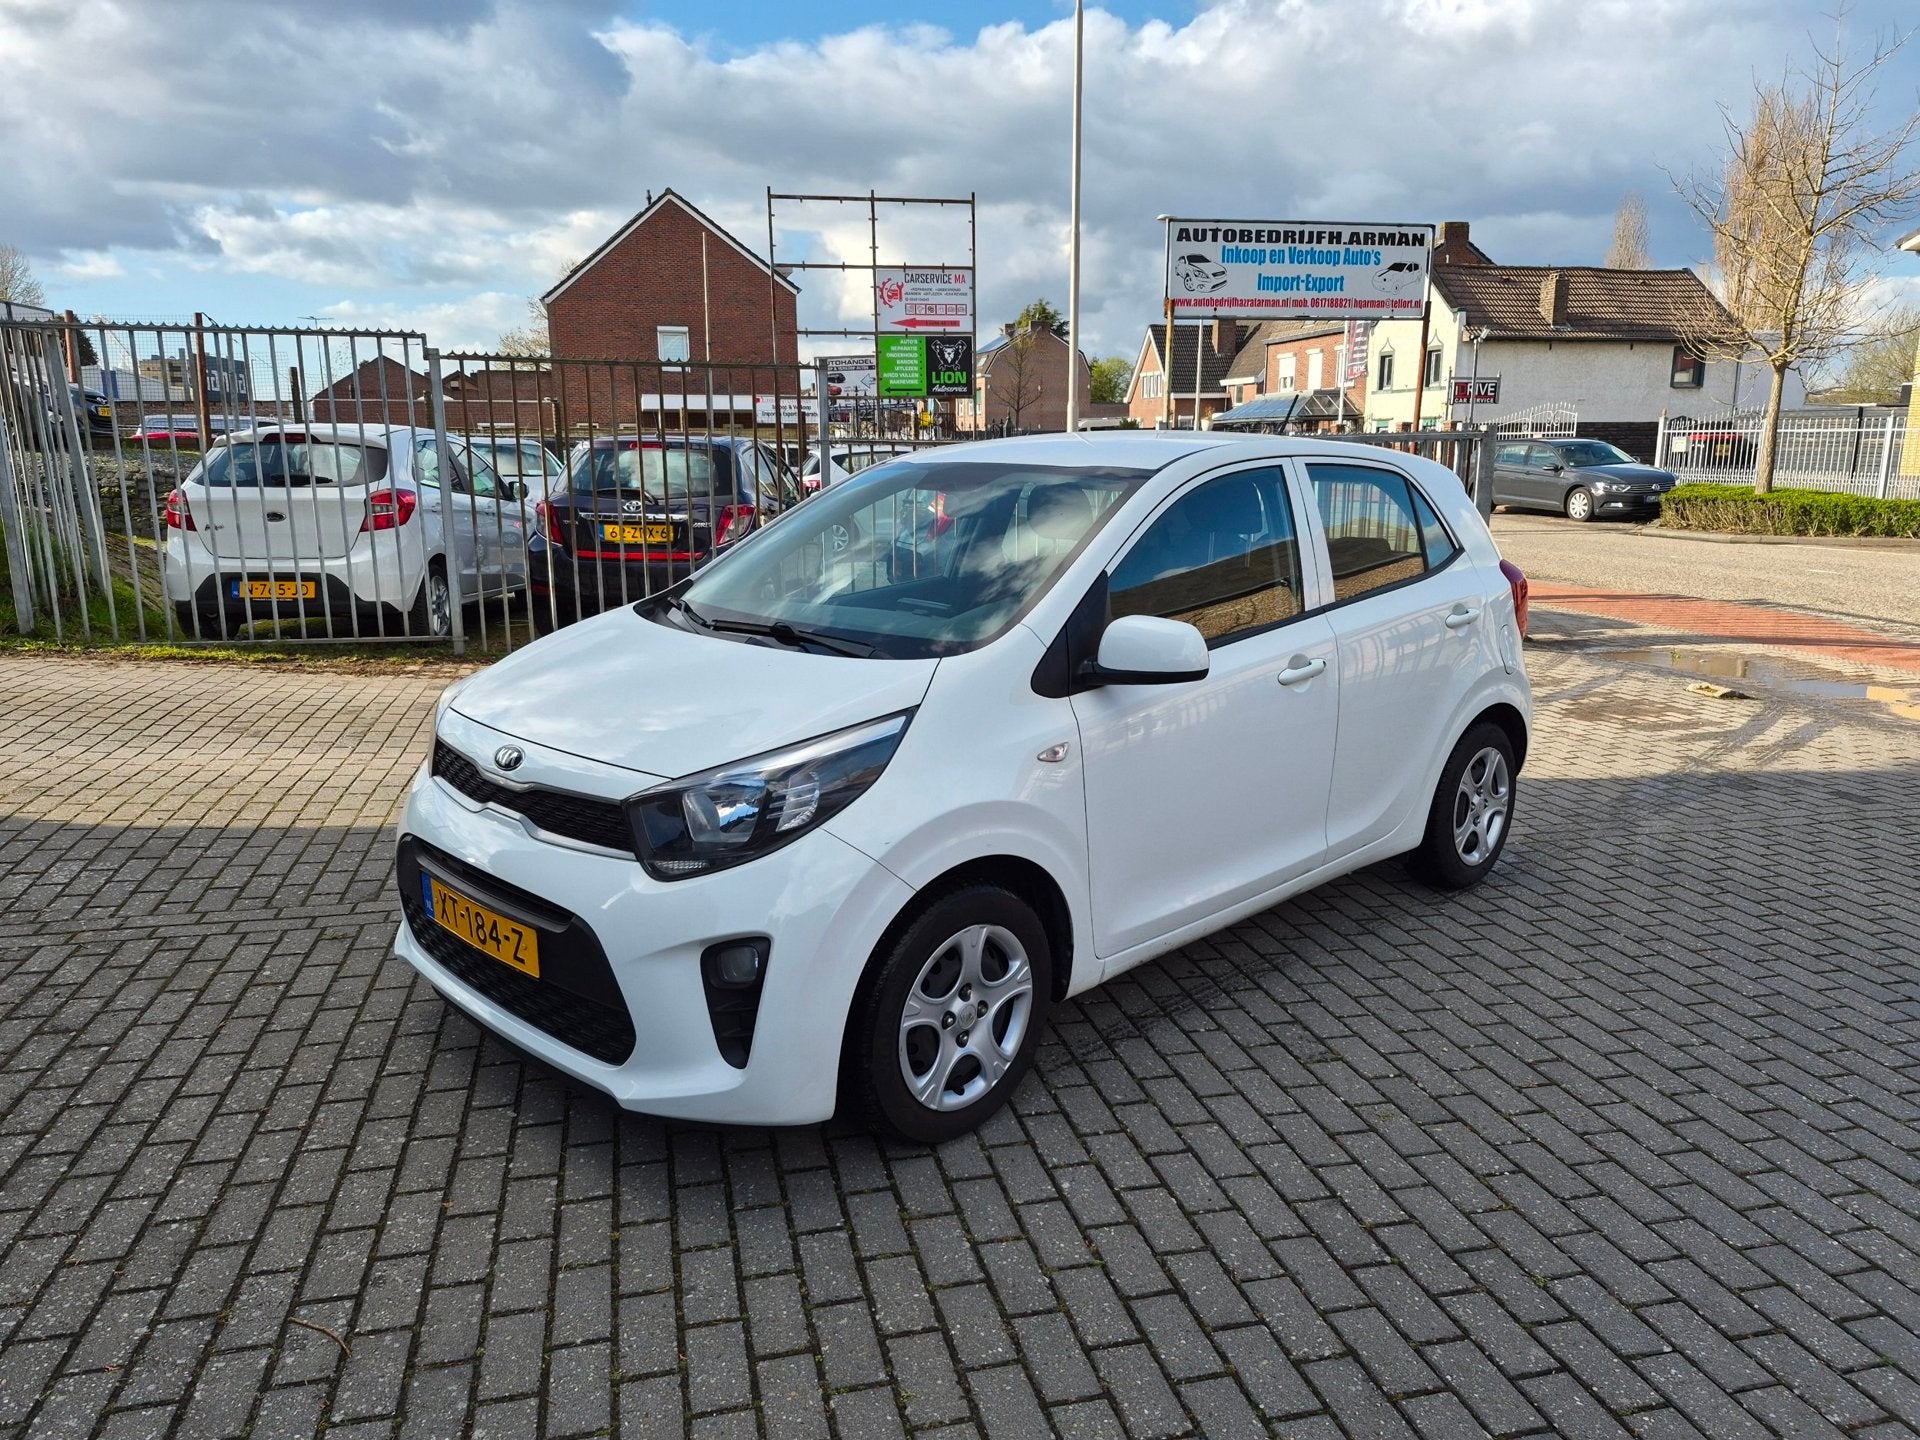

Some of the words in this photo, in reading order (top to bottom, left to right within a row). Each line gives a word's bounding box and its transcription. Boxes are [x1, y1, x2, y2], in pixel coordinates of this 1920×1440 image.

[1176, 227, 1425, 247] AUTOBEDRIJFH.ARMAN
[1221, 245, 1267, 266] Inkoop
[1269, 249, 1284, 265] en
[1288, 246, 1341, 267] Verkoop
[1343, 247, 1382, 266] Auto's
[904, 273, 952, 284] CARSERVICE
[954, 273, 966, 284] MA
[1257, 273, 1345, 294] Import-Export
[932, 371, 967, 384] LION
[932, 384, 968, 393] Autoservice
[438, 888, 527, 965] XT-184-Z
